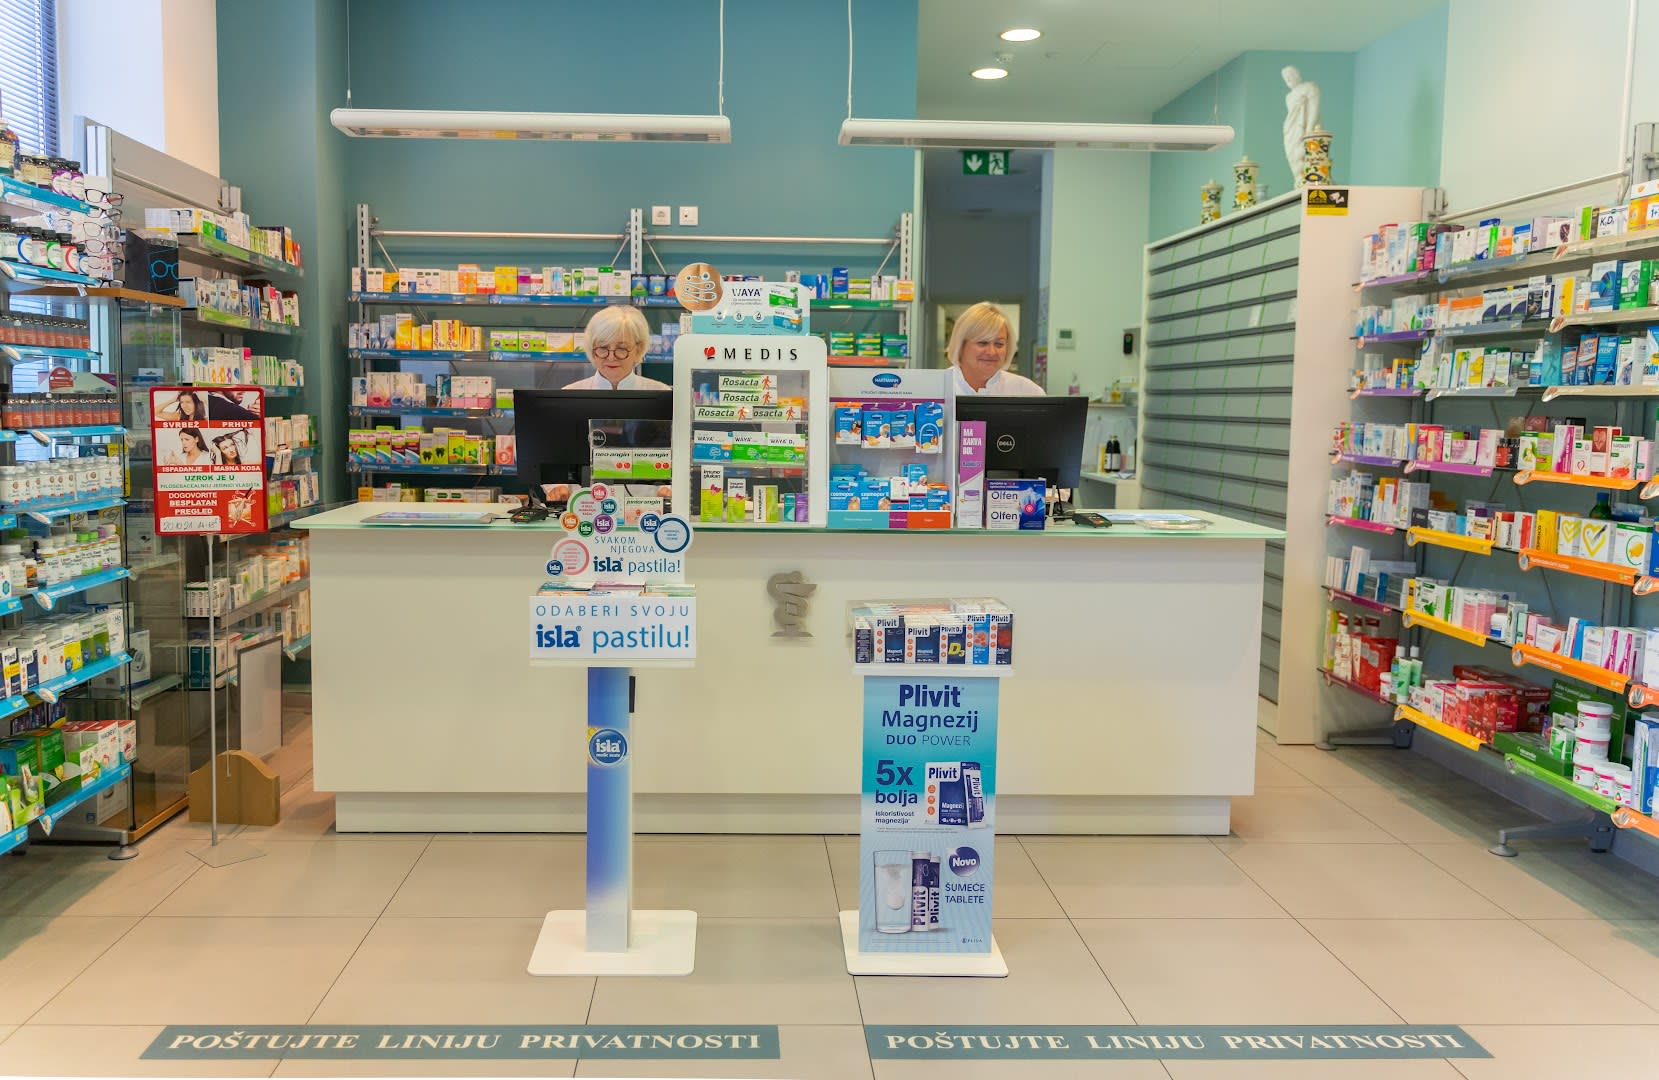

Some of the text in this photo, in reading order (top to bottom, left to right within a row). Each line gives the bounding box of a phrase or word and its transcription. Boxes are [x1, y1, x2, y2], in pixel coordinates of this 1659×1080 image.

[724, 348, 798, 361] MEDIS
[722, 377, 759, 386] Rosacta
[722, 394, 760, 402] Rosacta
[698, 408, 735, 417] Rosacta
[162, 420, 200, 428] SVRBEŽ
[991, 491, 1018, 500] Olfen
[990, 512, 1018, 520] Olfen
[596, 518, 610, 527] isla
[644, 518, 657, 527] isla
[594, 536, 636, 544] SVAKOM
[610, 545, 655, 554] NJEGOVA
[628, 558, 681, 576] pastila!
[536, 605, 689, 617] ODABERI SVOJU
[876, 619, 897, 627] Plivit
[967, 614, 985, 622] Plivit
[908, 628, 928, 636] Plivit
[592, 624, 690, 654] pastilu!
[899, 684, 961, 707] Plivit
[882, 710, 979, 733] Magnezij
[886, 734, 971, 746] DUO POWER
[876, 759, 914, 786] 5x
[928, 767, 957, 779] Plivit
[972, 777, 981, 795] Plivit
[875, 790, 918, 807] bolja
[953, 858, 976, 867] Novo
[945, 881, 985, 892] ŠUMEĆE
[945, 895, 984, 904] TABLETE
[913, 890, 926, 926] Plivit
[930, 892, 940, 924] Plivit
[168, 1031, 761, 1049] POŠTUJTE LINIJU PRIVATNOSTI
[884, 1032, 1466, 1050] POŠTUJTE LINIJU PRIVATNOSTI
